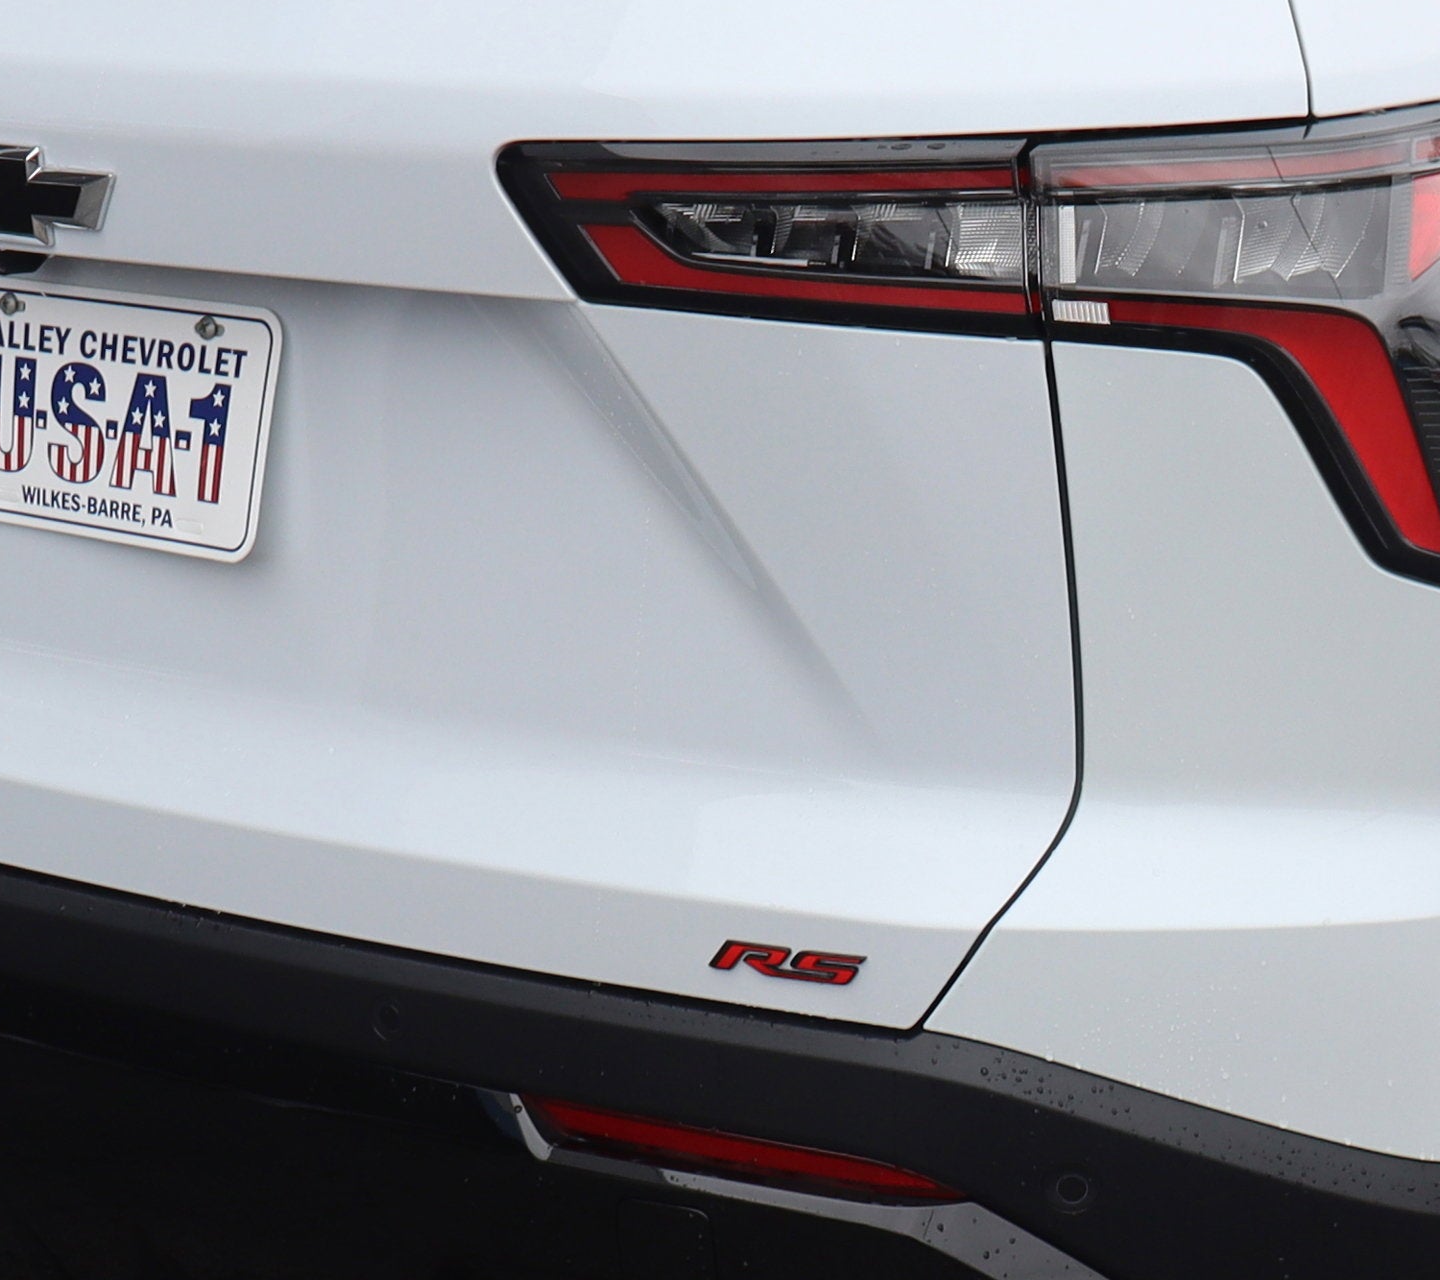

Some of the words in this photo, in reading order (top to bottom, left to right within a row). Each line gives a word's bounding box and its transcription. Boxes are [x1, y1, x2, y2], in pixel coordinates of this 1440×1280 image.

[79, 329, 248, 379] CHEVROLET
[21, 484, 147, 528] WILKES-BARRE,
[151, 507, 174, 529] PA
[708, 939, 868, 986] RS
